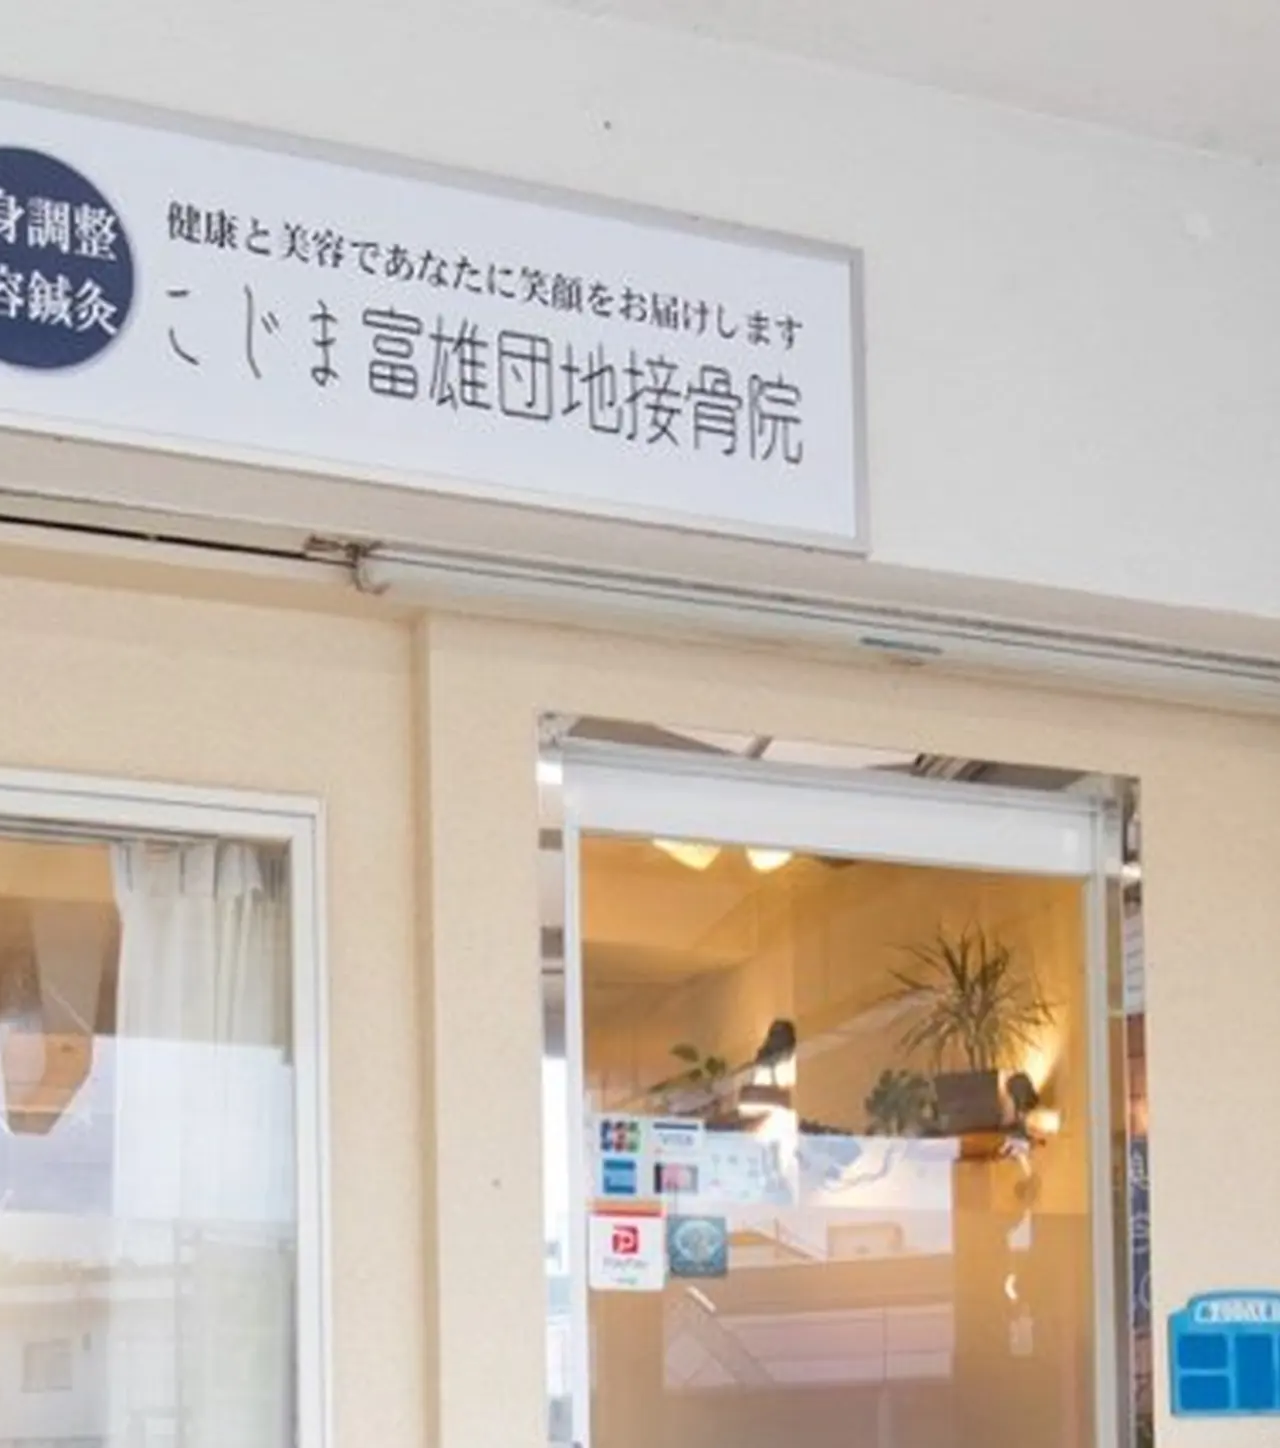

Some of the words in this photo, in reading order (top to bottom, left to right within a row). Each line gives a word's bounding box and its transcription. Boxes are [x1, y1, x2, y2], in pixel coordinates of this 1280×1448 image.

[167, 201, 804, 350] 健康と美容であなたに笑顔をお届けします
[167, 284, 804, 465] こじま富雄団地接骨院
